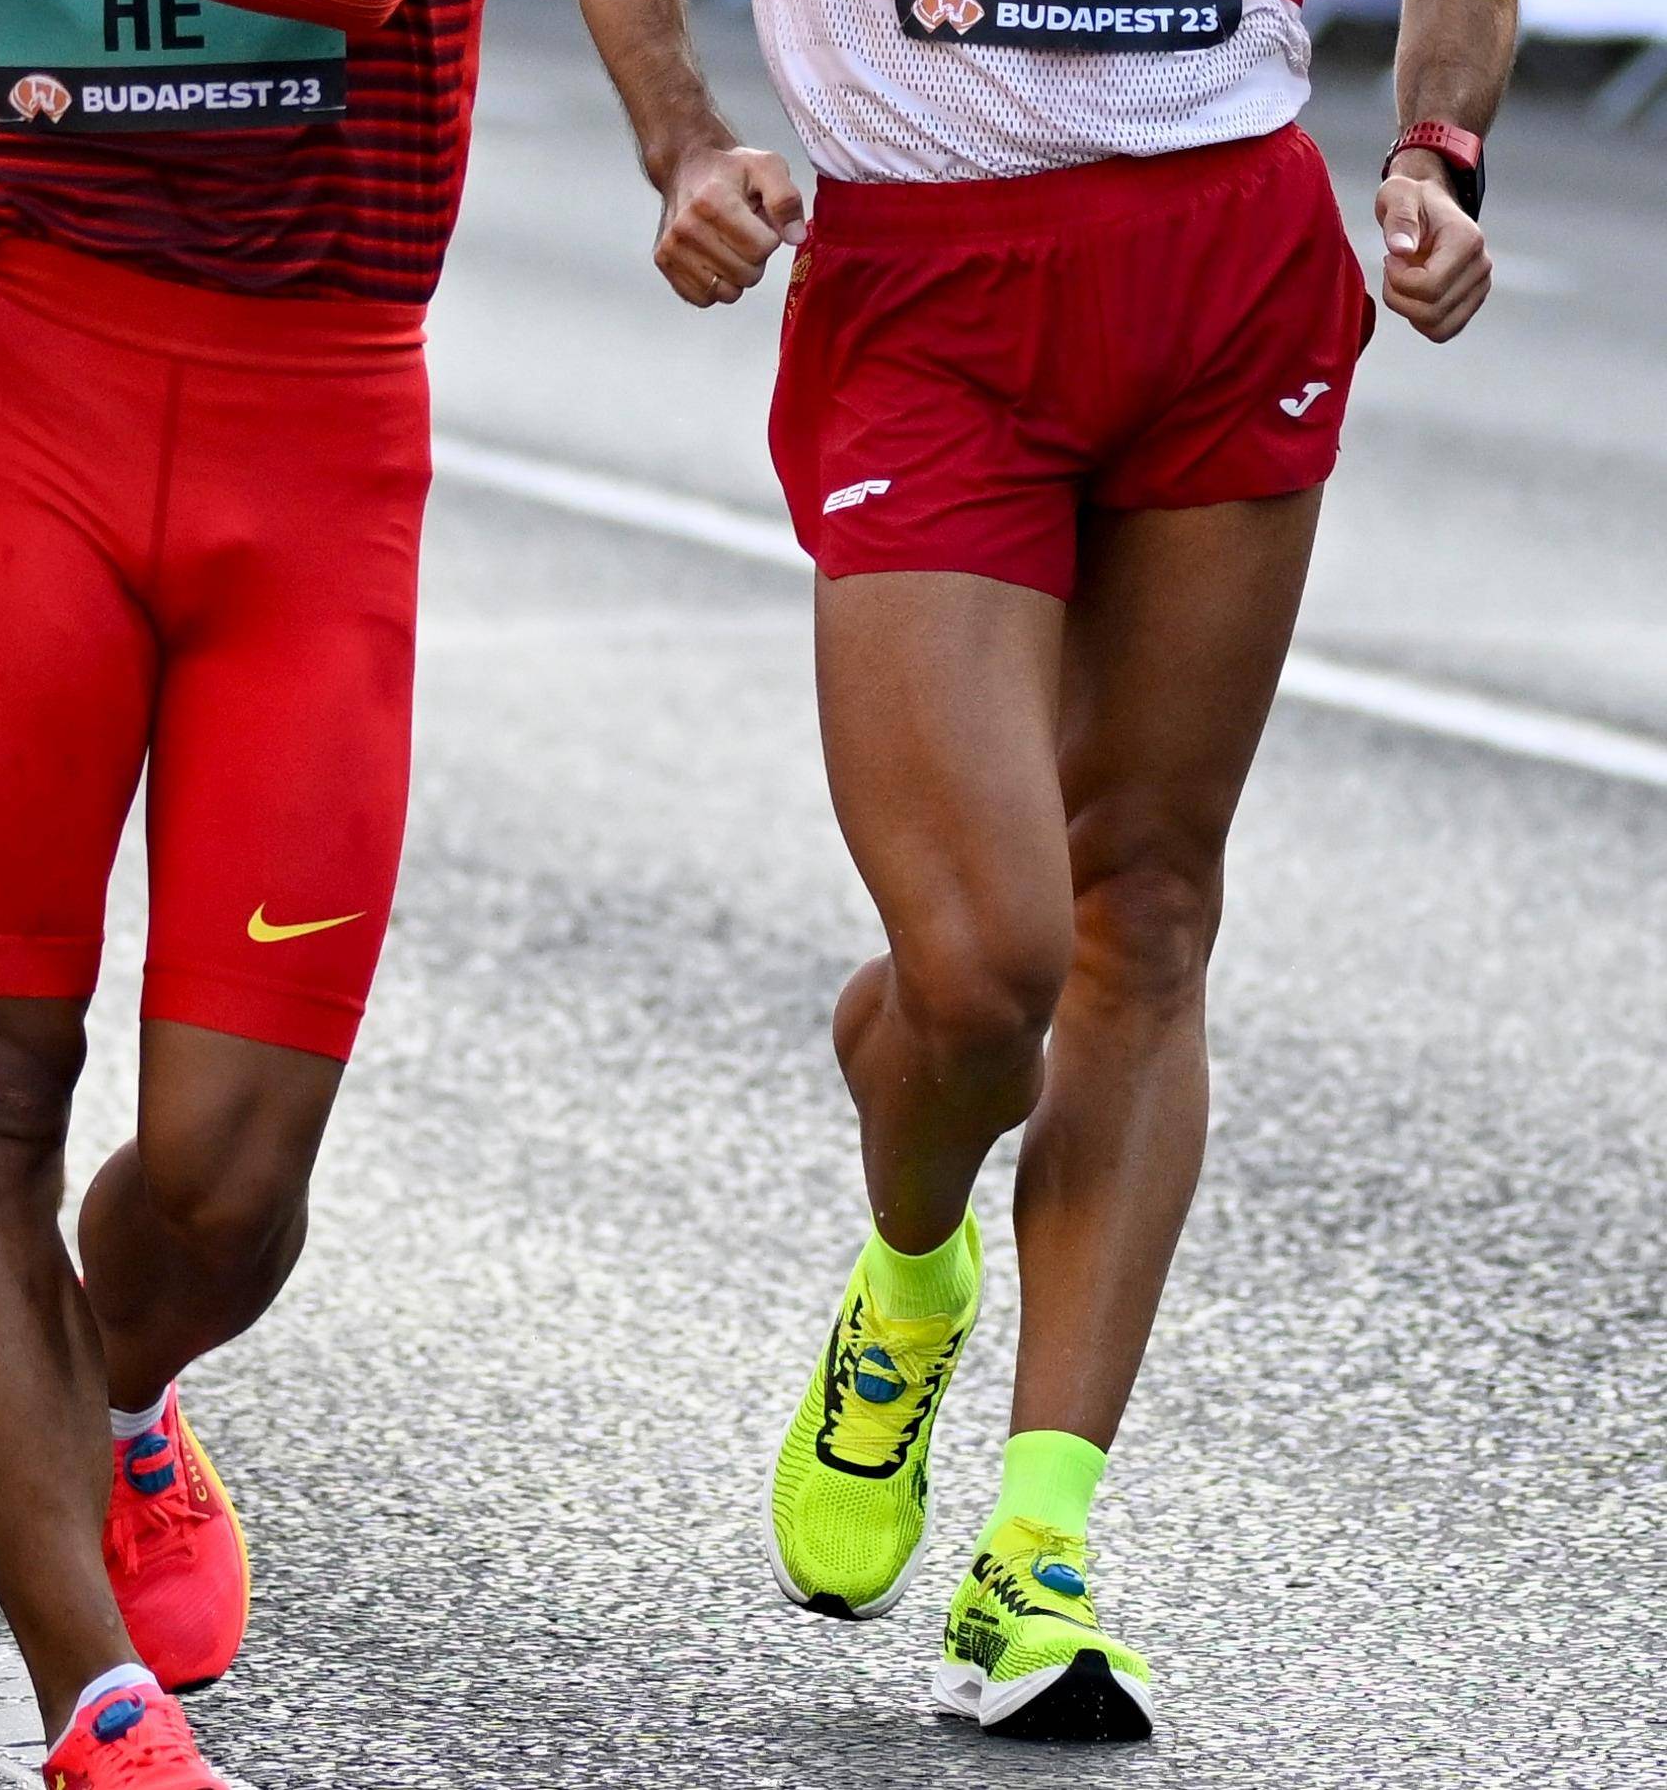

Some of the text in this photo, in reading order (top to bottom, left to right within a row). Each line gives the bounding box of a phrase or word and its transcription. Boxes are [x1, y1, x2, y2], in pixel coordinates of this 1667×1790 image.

[996, 2, 1218, 33] BUDAPEST 23
[82, 78, 322, 113] BUDAPEST 23
[822, 479, 892, 516] ESP
